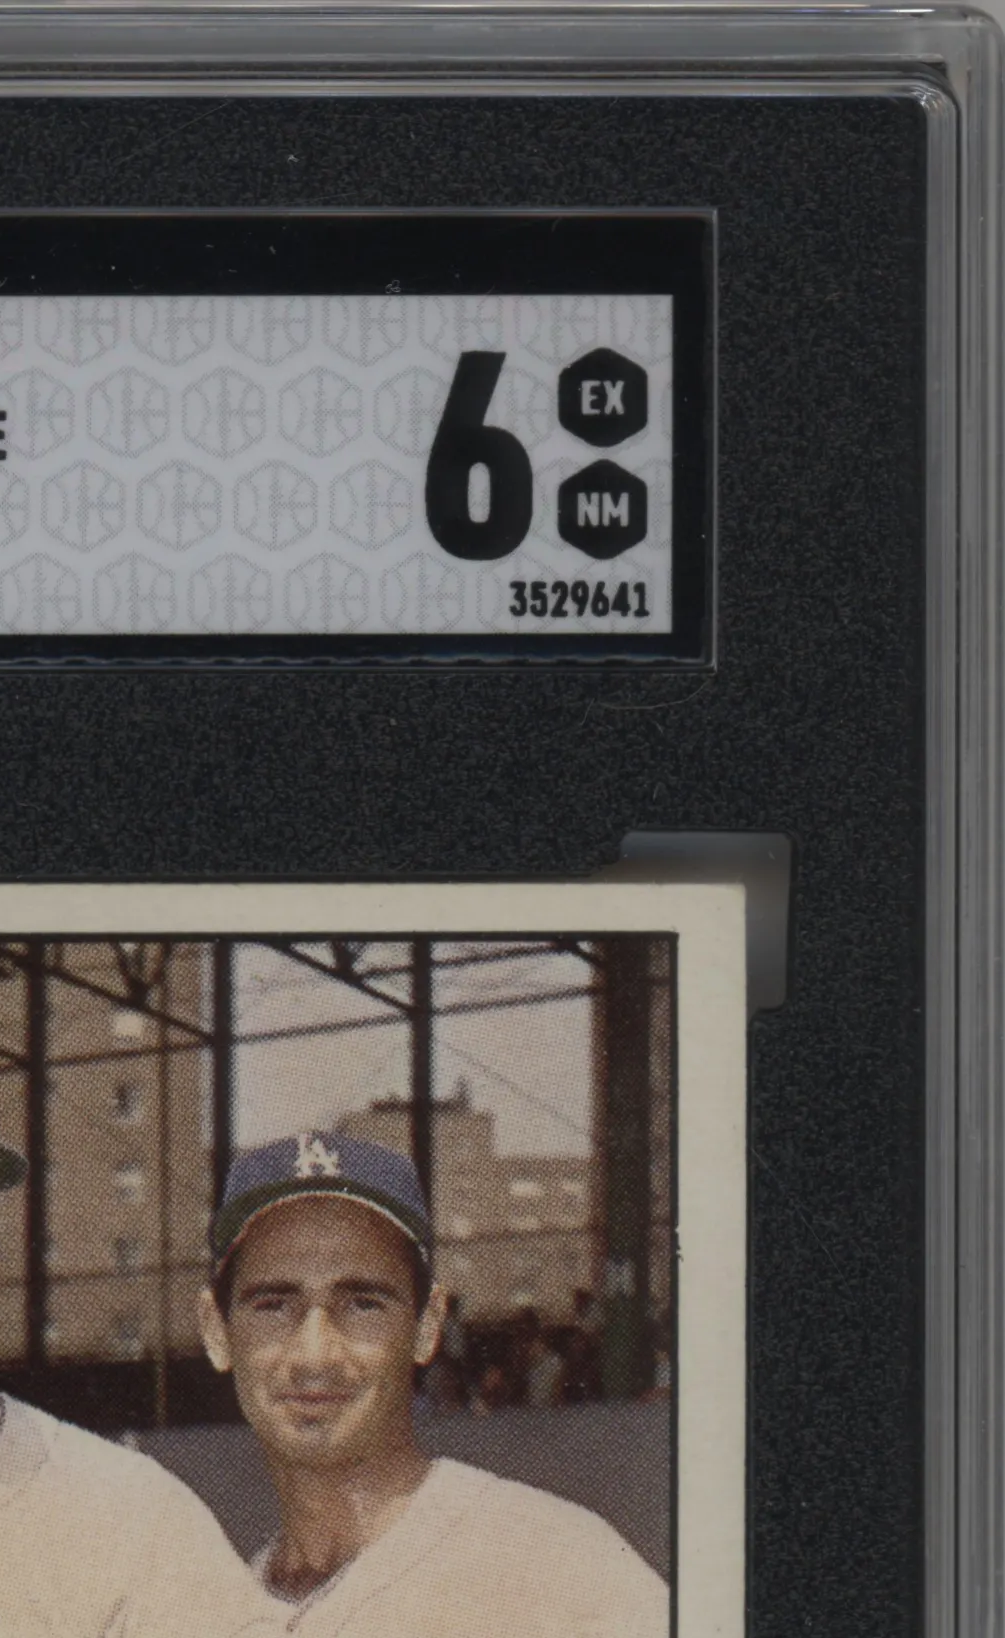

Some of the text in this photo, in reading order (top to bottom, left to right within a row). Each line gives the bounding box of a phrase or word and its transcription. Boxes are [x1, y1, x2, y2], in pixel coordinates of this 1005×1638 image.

[580, 379, 625, 416] EX
[425, 350, 534, 561] 6
[576, 491, 630, 528] NM
[509, 581, 650, 618] 3529641
[295, 1130, 341, 1177] LA
